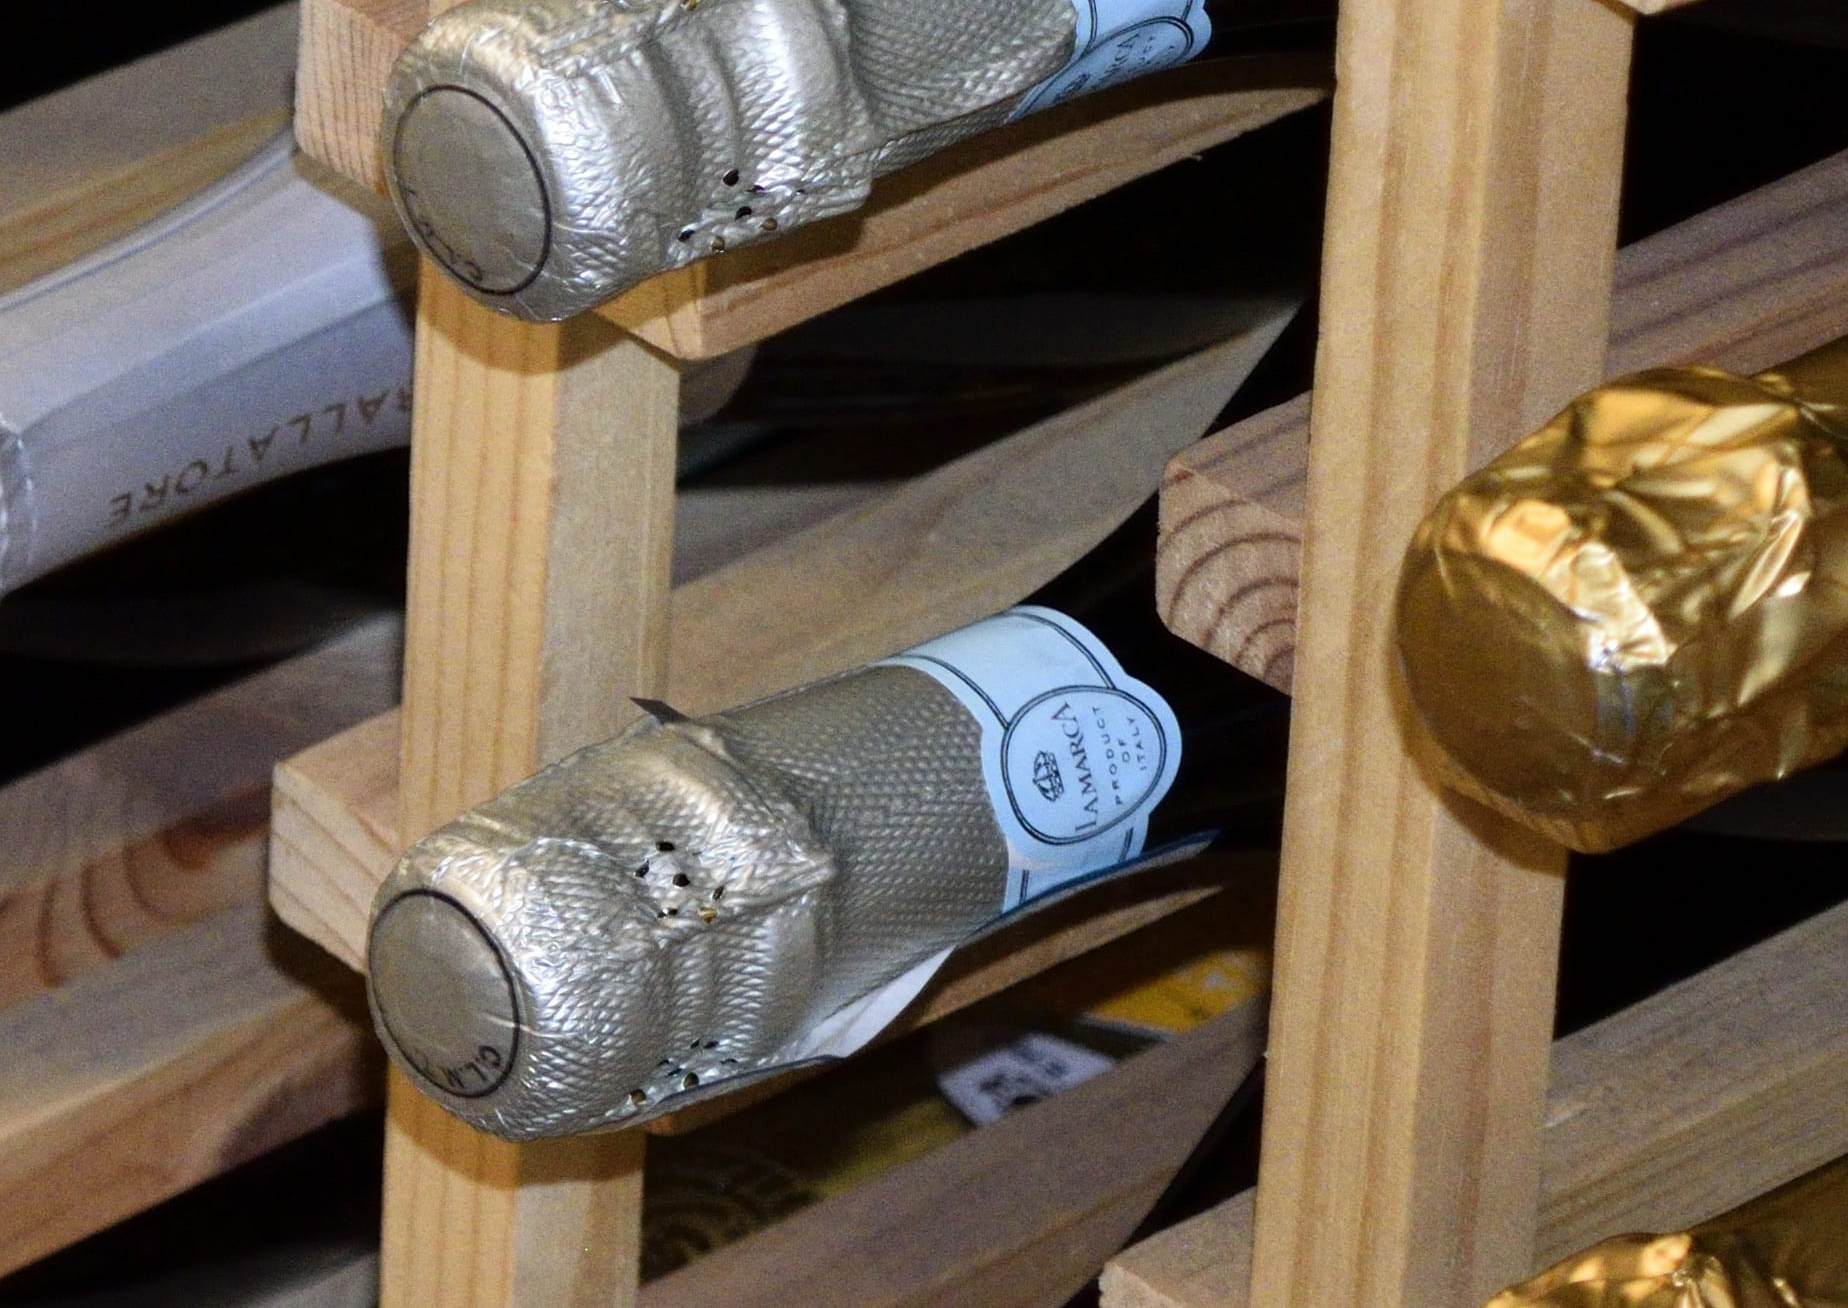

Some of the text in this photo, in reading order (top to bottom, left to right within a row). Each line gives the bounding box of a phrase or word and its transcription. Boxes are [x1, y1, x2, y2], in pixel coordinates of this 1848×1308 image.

[1092, 706, 1124, 805] PRODUCT
[1118, 739, 1132, 764] OF
[1126, 717, 1148, 771] ITALY
